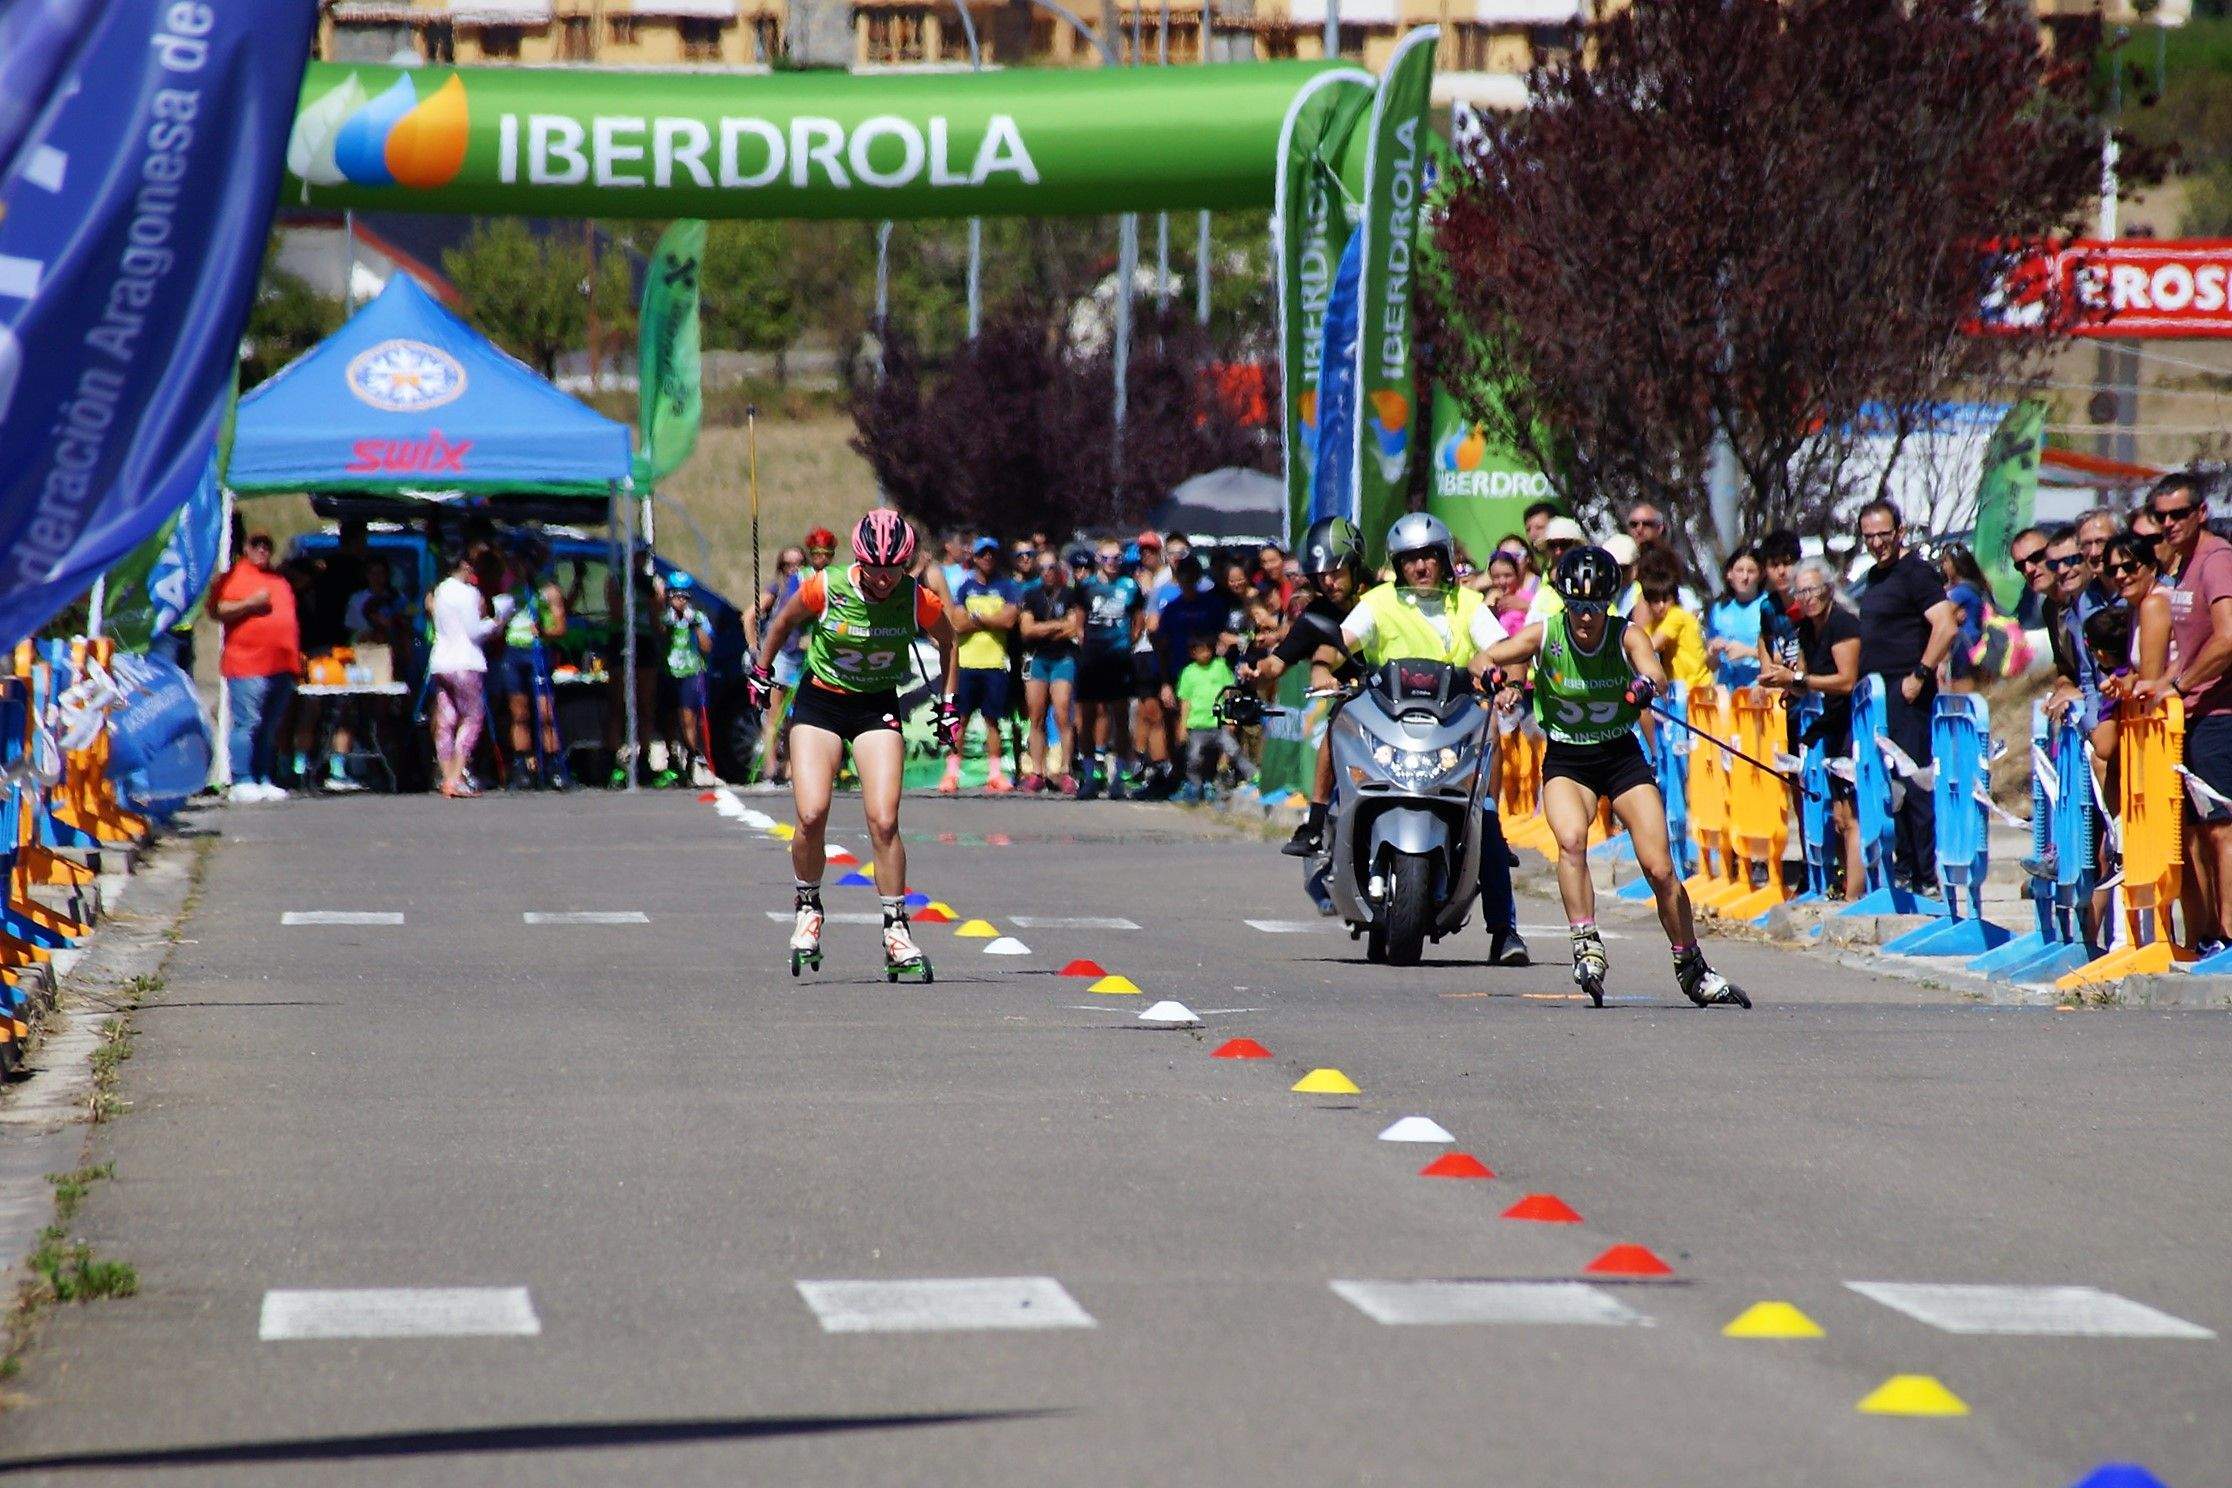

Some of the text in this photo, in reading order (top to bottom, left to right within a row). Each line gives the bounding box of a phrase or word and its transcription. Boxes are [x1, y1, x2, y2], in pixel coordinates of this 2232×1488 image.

[499, 112, 1041, 189] IBERDROLA
[1382, 116, 1419, 380] IBERDROLA
[13, 367, 122, 581] deración
[85, 87, 201, 362] Aragonesa
[149, 1, 215, 73] de
[2075, 263, 2232, 312] EROS
[1437, 470, 1559, 498] IBERDRO
